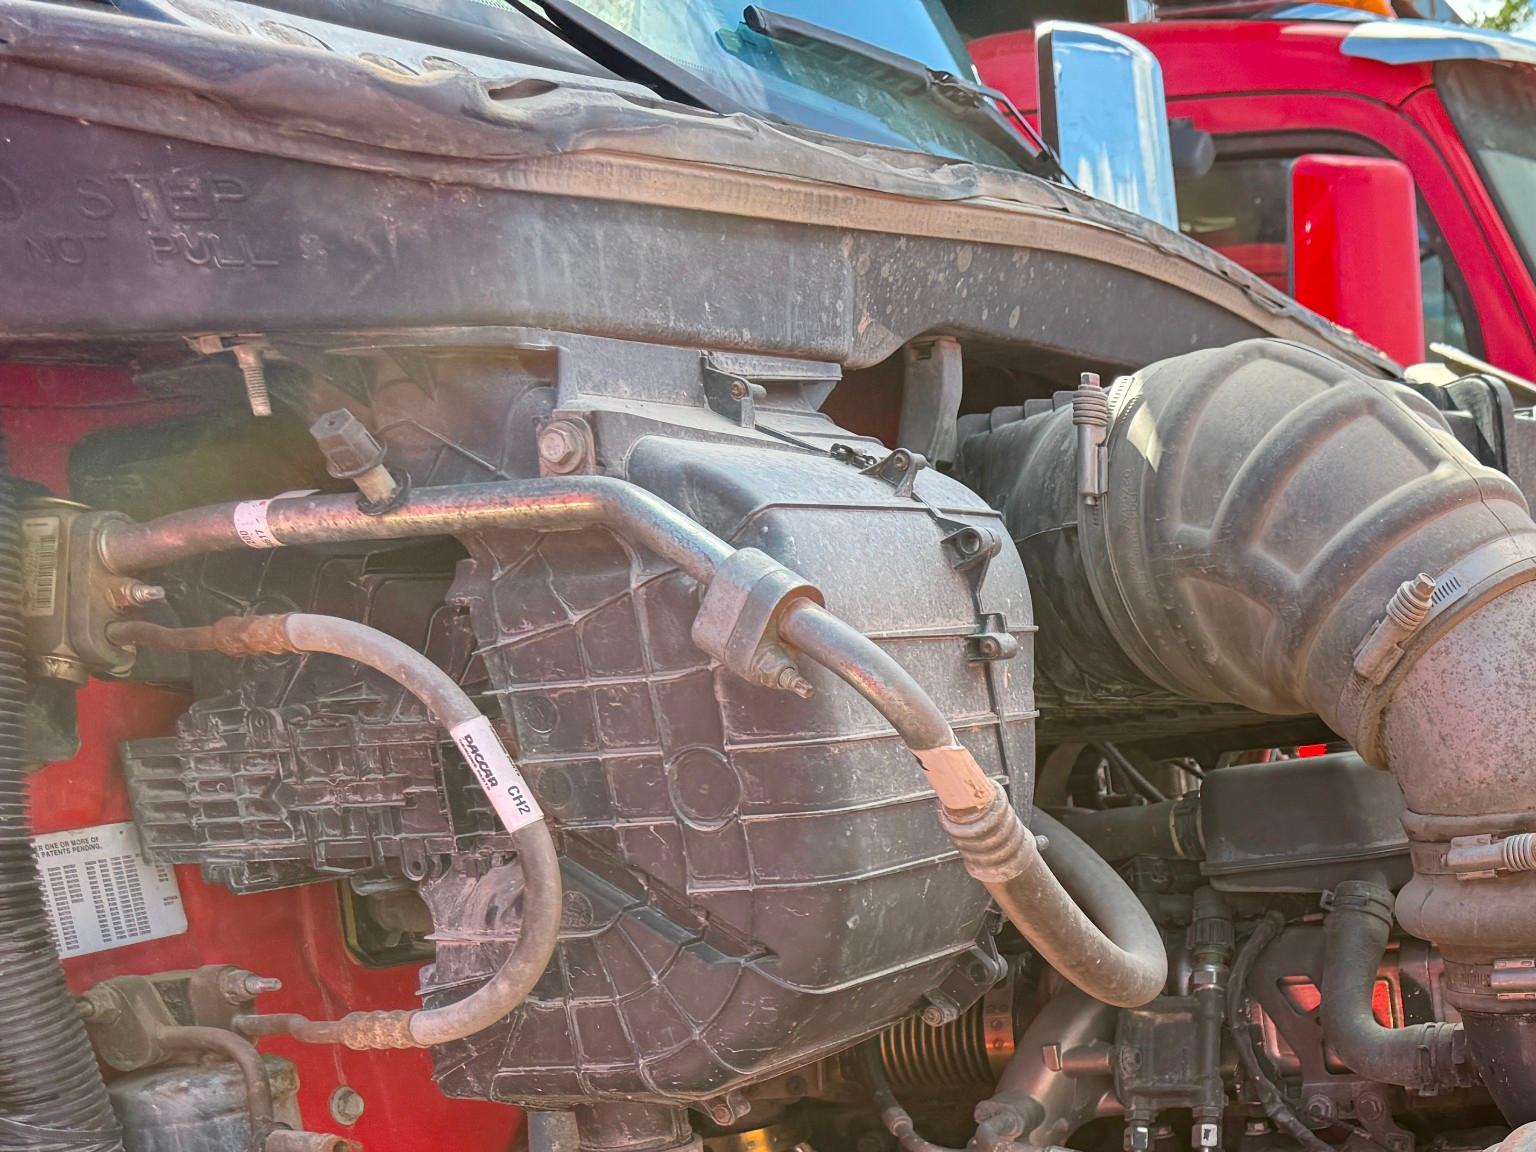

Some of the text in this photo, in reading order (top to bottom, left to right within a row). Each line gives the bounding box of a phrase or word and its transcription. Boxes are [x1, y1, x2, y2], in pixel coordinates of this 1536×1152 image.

[76, 173, 250, 222] STEP
[146, 230, 280, 271] PULL
[463, 734, 531, 815] PACCAR CH2
